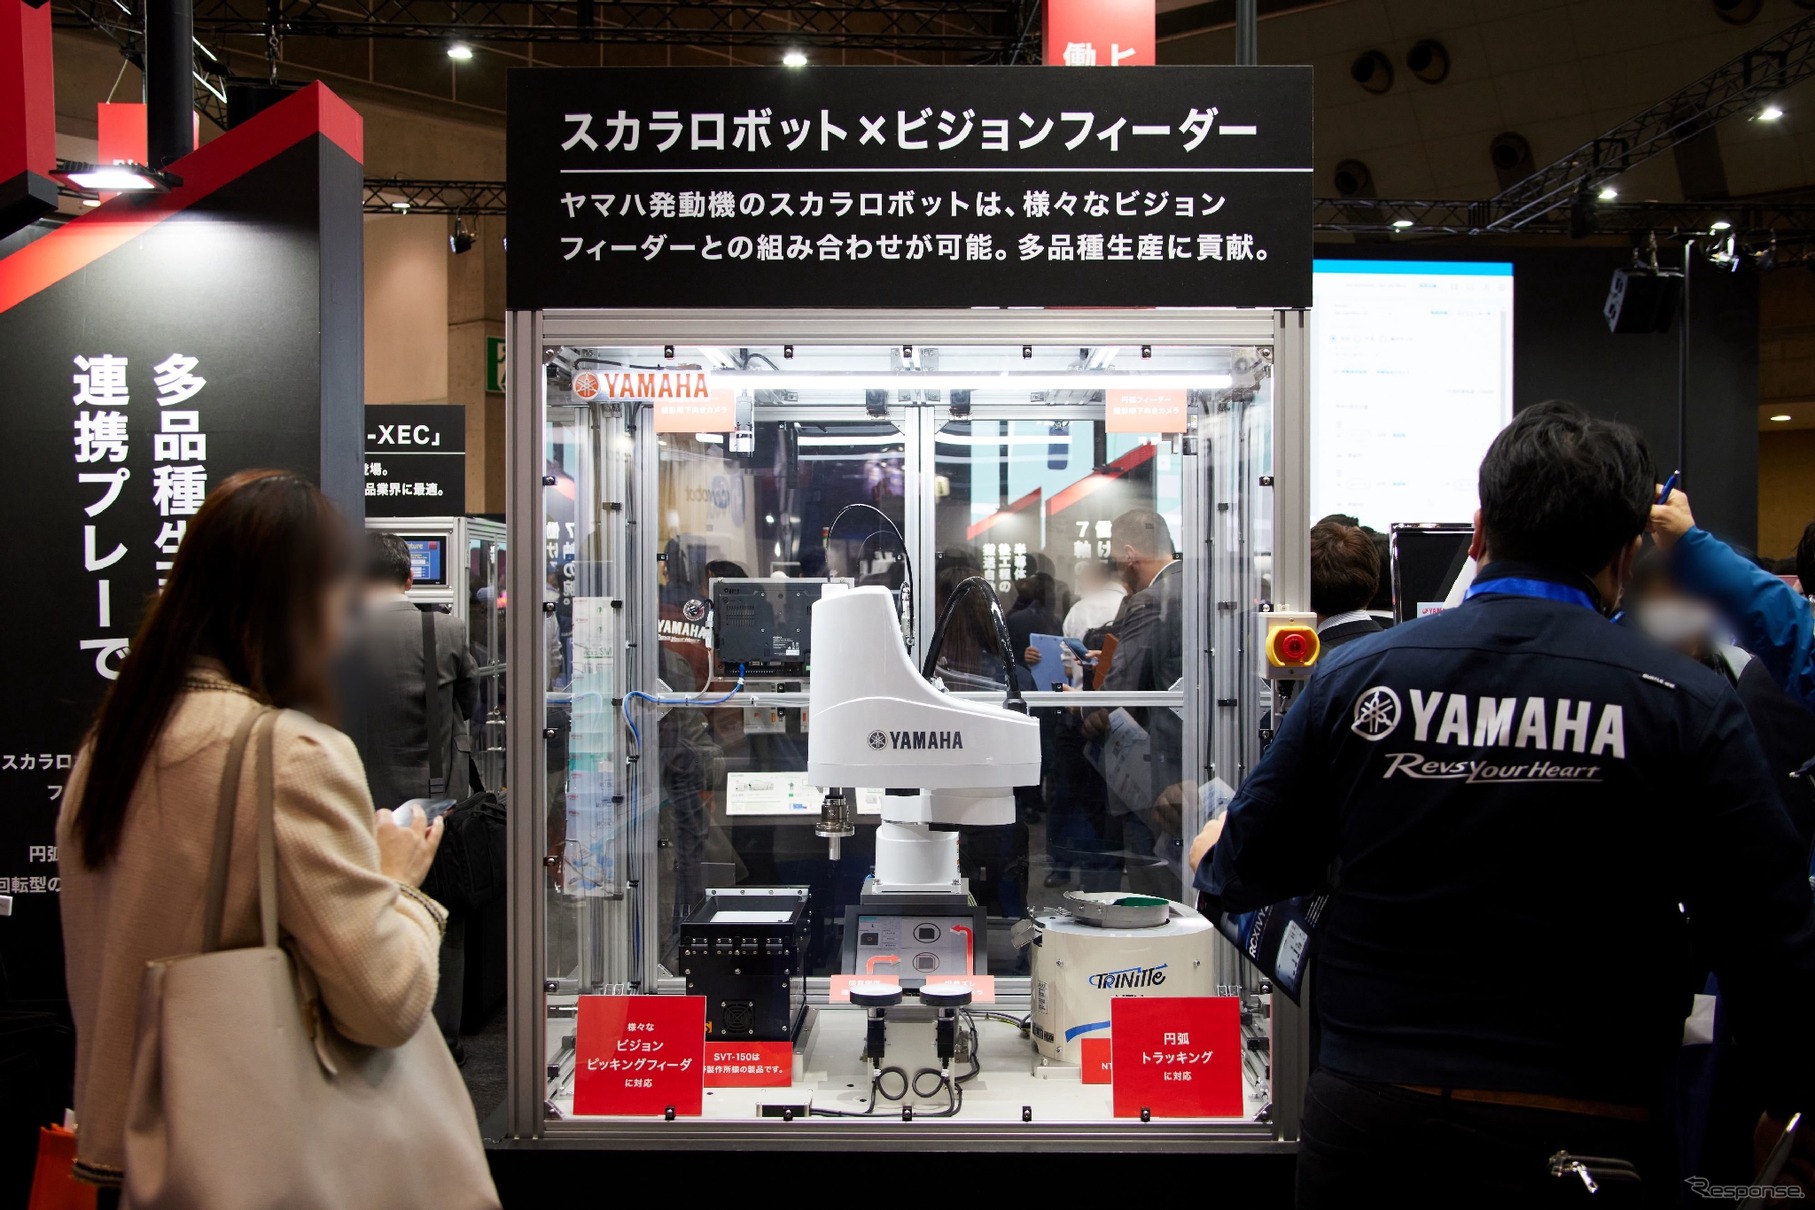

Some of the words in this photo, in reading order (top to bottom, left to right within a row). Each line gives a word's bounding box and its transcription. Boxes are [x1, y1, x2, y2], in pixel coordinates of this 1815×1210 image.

[560, 107, 1257, 152] スカラロボット×ビジョンフィーダー
[604, 373, 709, 398] YAMAHA
[152, 352, 207, 597] 多品種生
[1409, 688, 1625, 759] YAMAHA
[889, 731, 963, 750] YAMAHA
[627, 1022, 655, 1032] 様々な
[616, 1039, 664, 1052] ビジョン
[1163, 1032, 1190, 1046] 円弧
[1142, 1050, 1214, 1065] トラッキング
[624, 1078, 653, 1088] に対応
[1163, 1071, 1192, 1081] に対応
